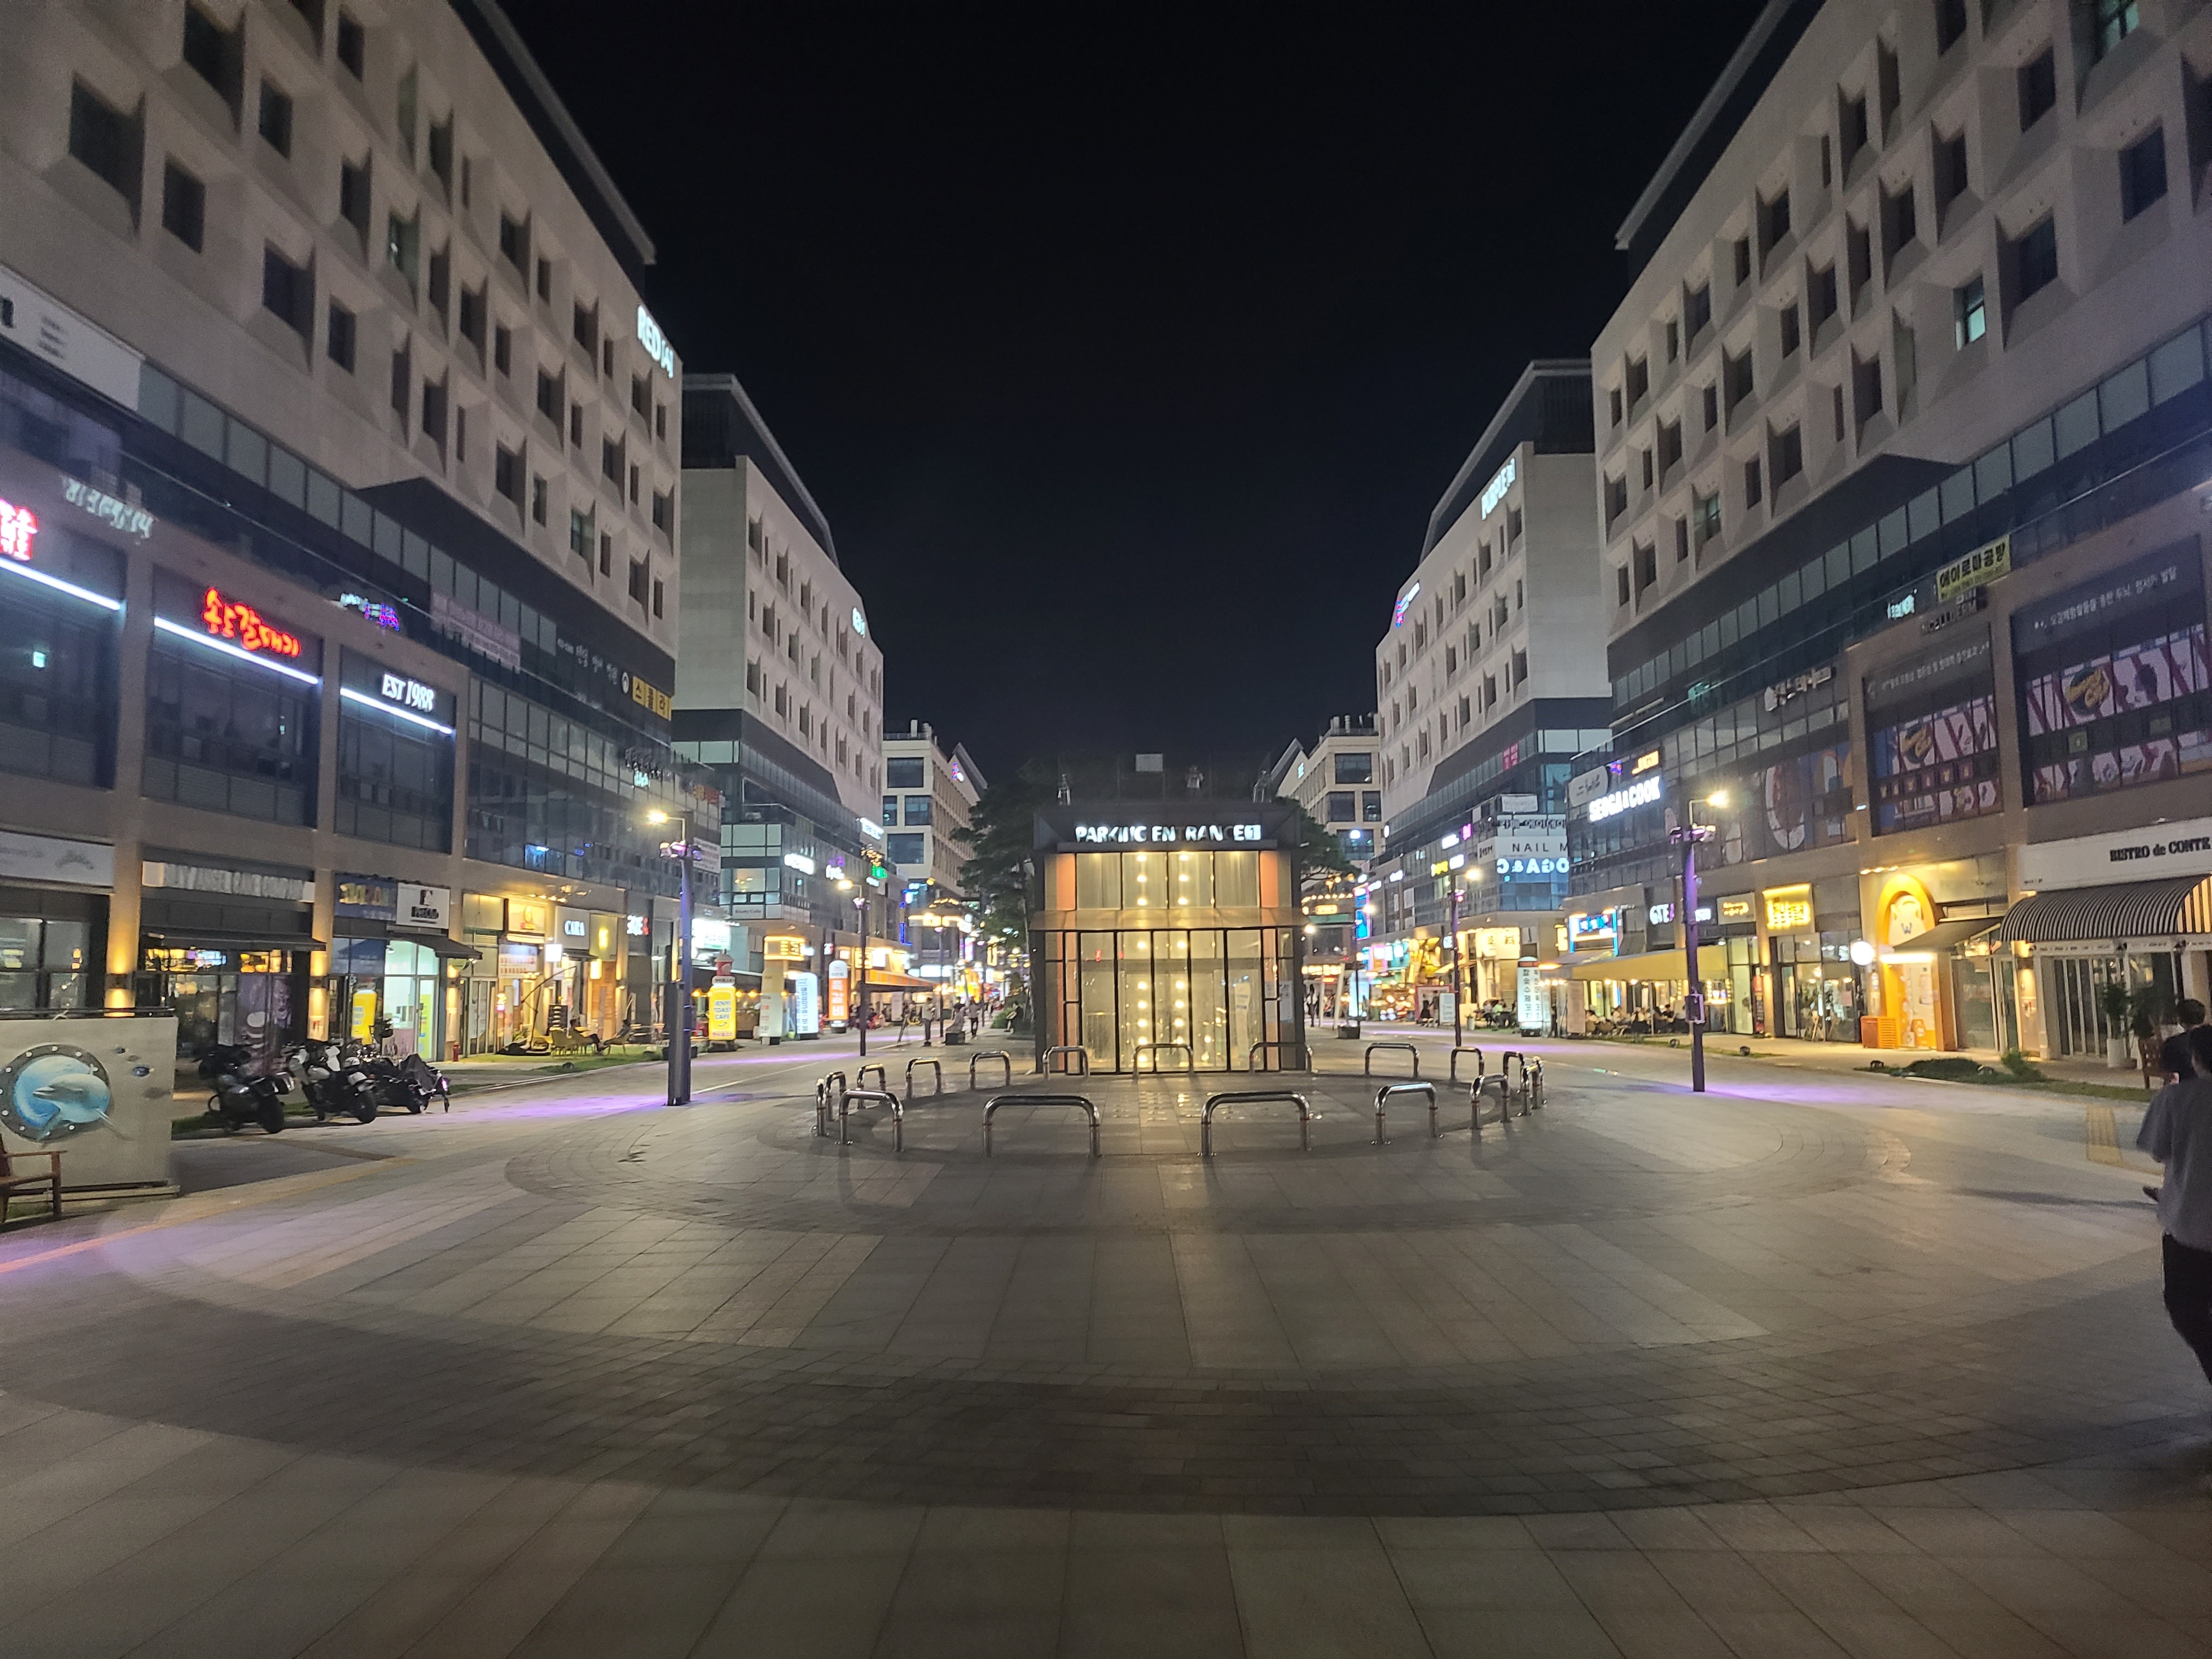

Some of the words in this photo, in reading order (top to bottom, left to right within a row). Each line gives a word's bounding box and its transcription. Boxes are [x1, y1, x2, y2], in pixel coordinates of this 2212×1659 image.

[382, 674, 405, 700] EST
[405, 680, 435, 713] 1988
[1589, 776, 1661, 822] SEOGA&COOK
[1512, 843, 1549, 852] NAIL
[2110, 845, 2150, 862] BISTRO
[2153, 843, 2166, 856] de
[2168, 837, 2211, 854] CONTE
